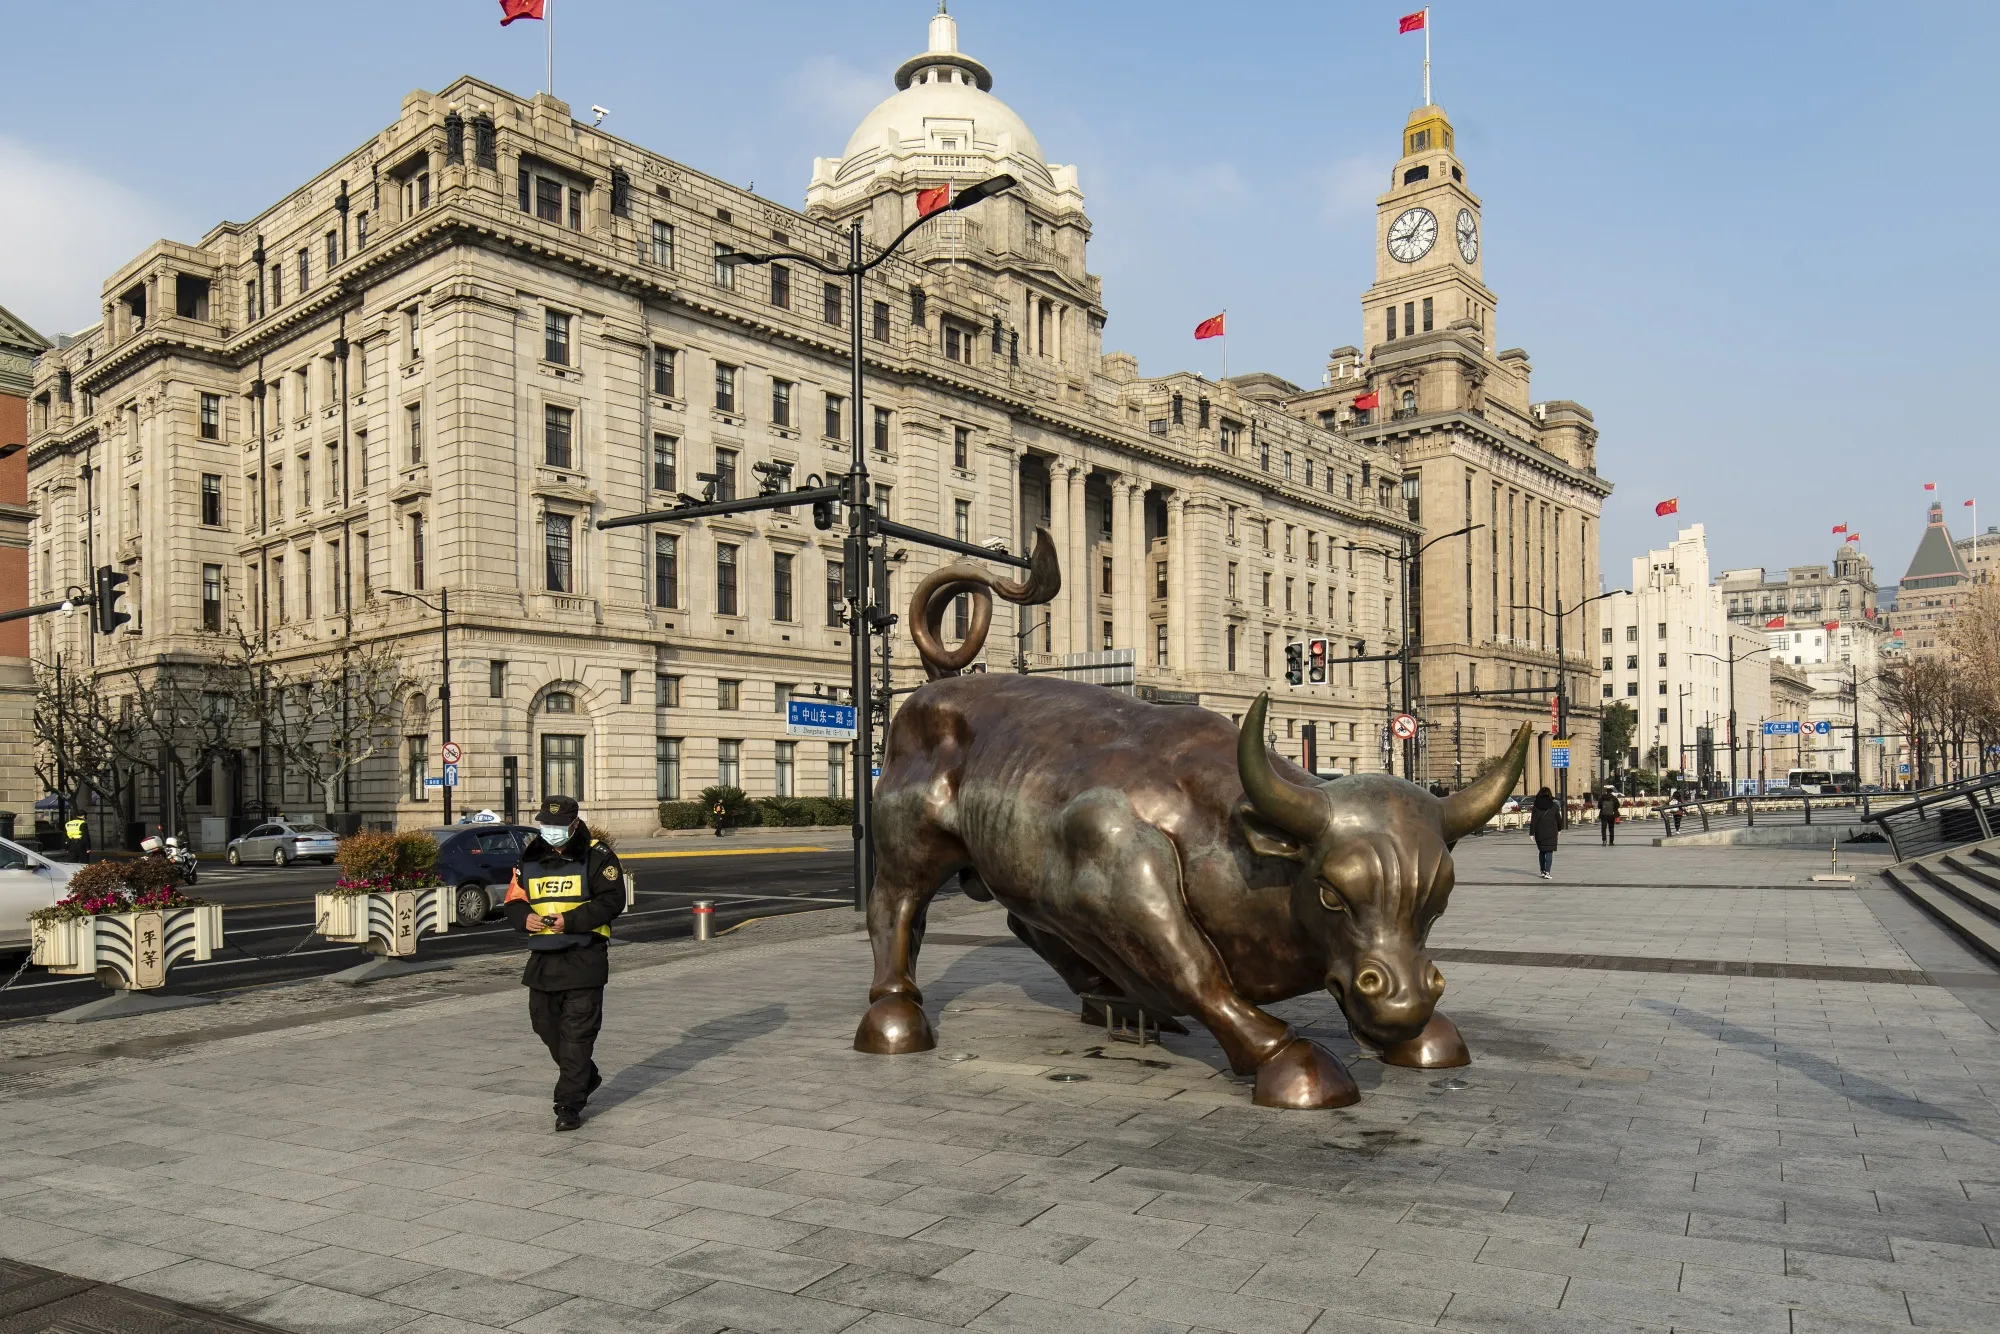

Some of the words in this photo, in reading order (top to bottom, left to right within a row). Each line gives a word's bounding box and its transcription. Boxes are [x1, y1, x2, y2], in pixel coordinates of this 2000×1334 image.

[802, 707, 844, 725] 中山东一路
[536, 880, 573, 894] VSP
[399, 908, 412, 938] 公正
[141, 930, 159, 969] 平等
